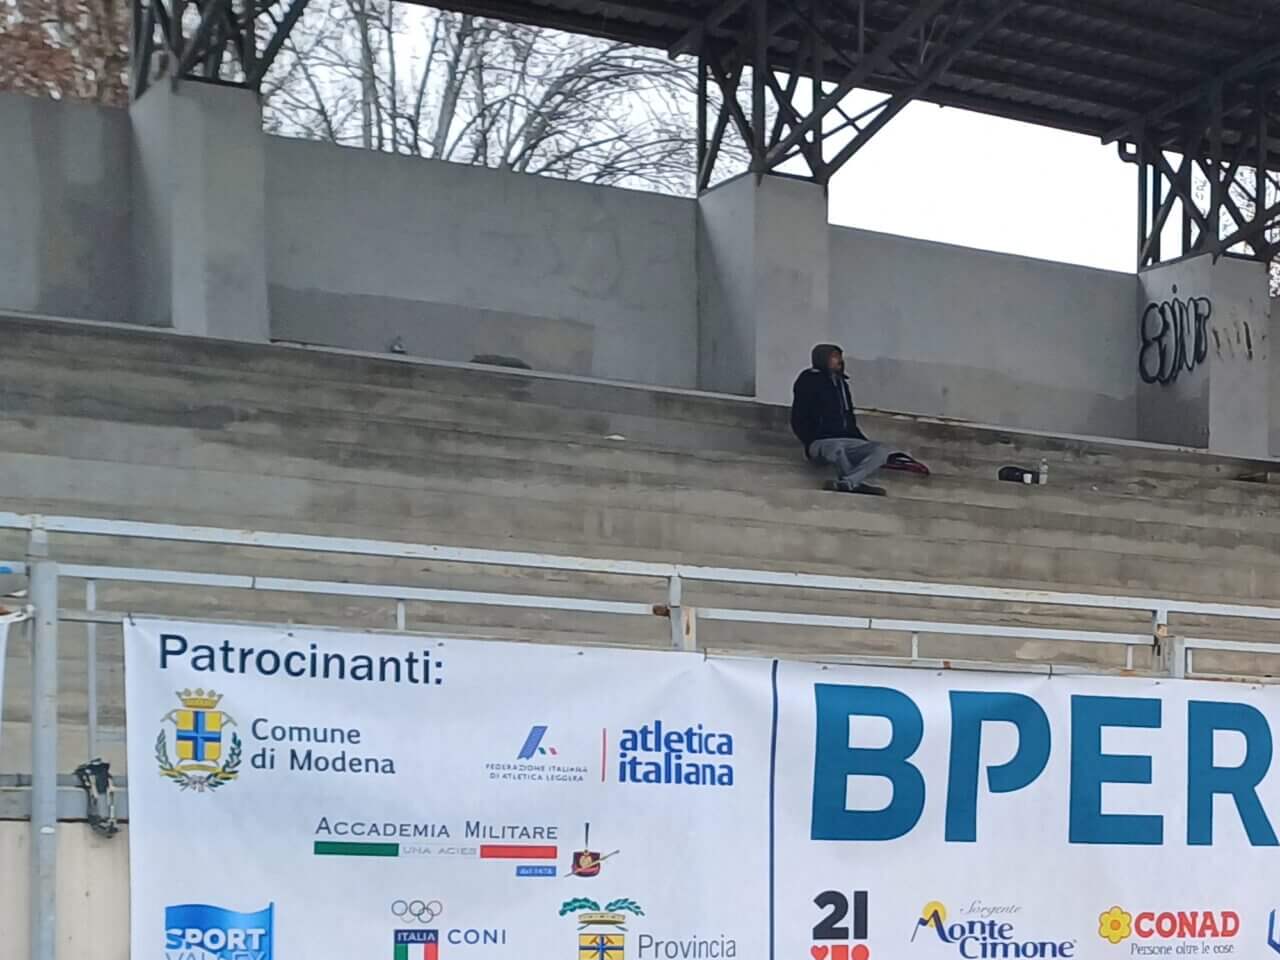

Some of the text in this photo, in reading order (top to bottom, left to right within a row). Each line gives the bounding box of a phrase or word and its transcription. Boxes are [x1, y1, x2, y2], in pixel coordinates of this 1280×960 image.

[159, 634, 444, 686] Patrocinanti:
[251, 718, 361, 746] Comune
[619, 719, 733, 756] atletica
[251, 748, 396, 776] di Modena
[619, 752, 733, 787] italiana
[811, 889, 869, 941] 21
[1134, 911, 1240, 938] CONAD
[165, 928, 266, 950] SPORT
[397, 932, 437, 943] ITALIA
[447, 928, 507, 945] CONI
[637, 933, 737, 960] Provincia
[959, 936, 1075, 960] Cimone
[1130, 942, 1235, 956] Persone oltre le cose
